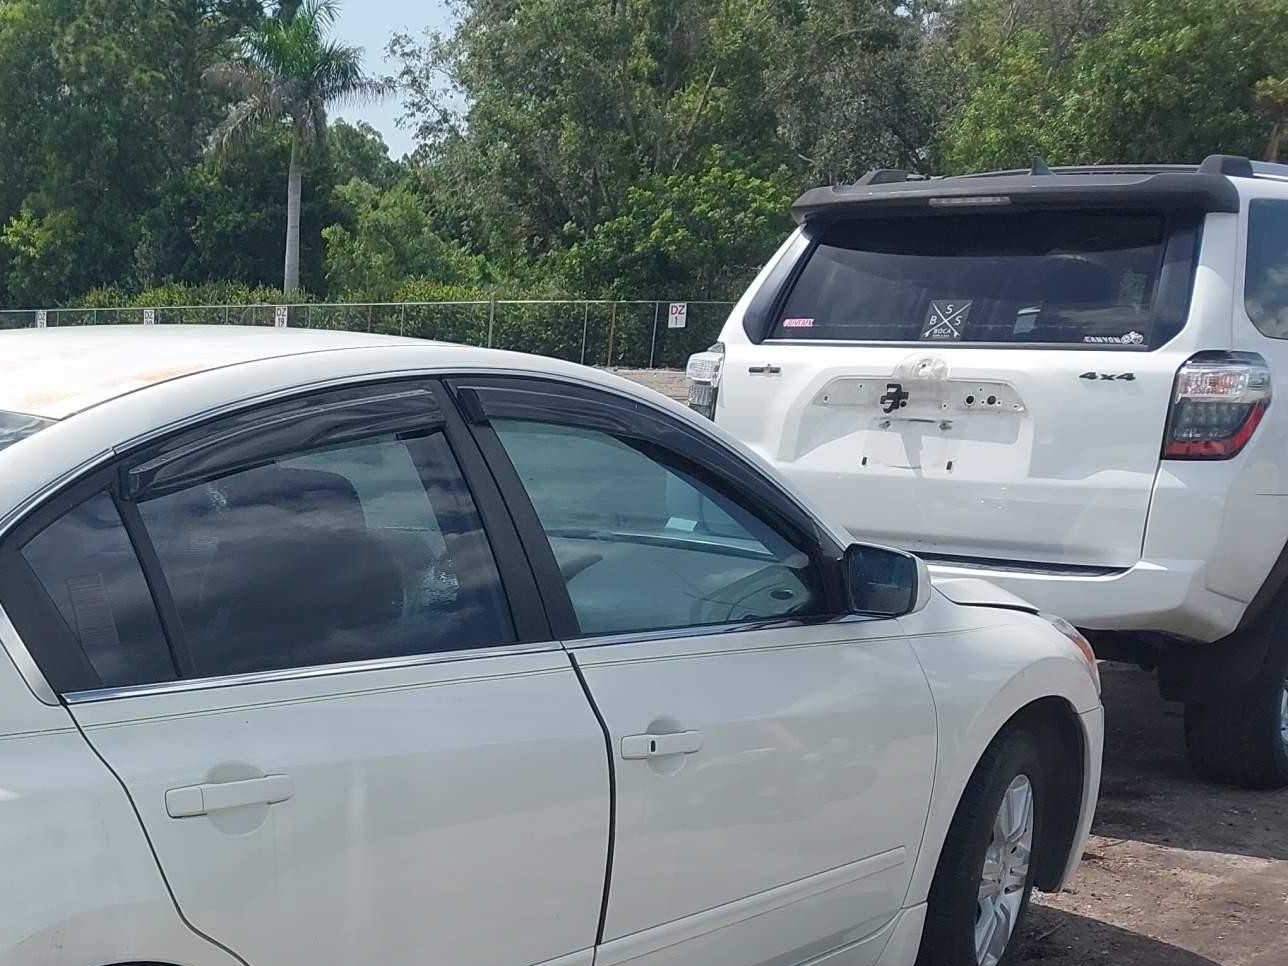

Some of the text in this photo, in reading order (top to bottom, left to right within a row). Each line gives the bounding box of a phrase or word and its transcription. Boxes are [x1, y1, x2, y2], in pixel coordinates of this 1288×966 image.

[276, 307, 287, 317] DZ
[670, 304, 686, 315] DZ
[945, 304, 954, 314] S
[144, 311, 154, 320] DZ
[929, 315, 963, 326] B S
